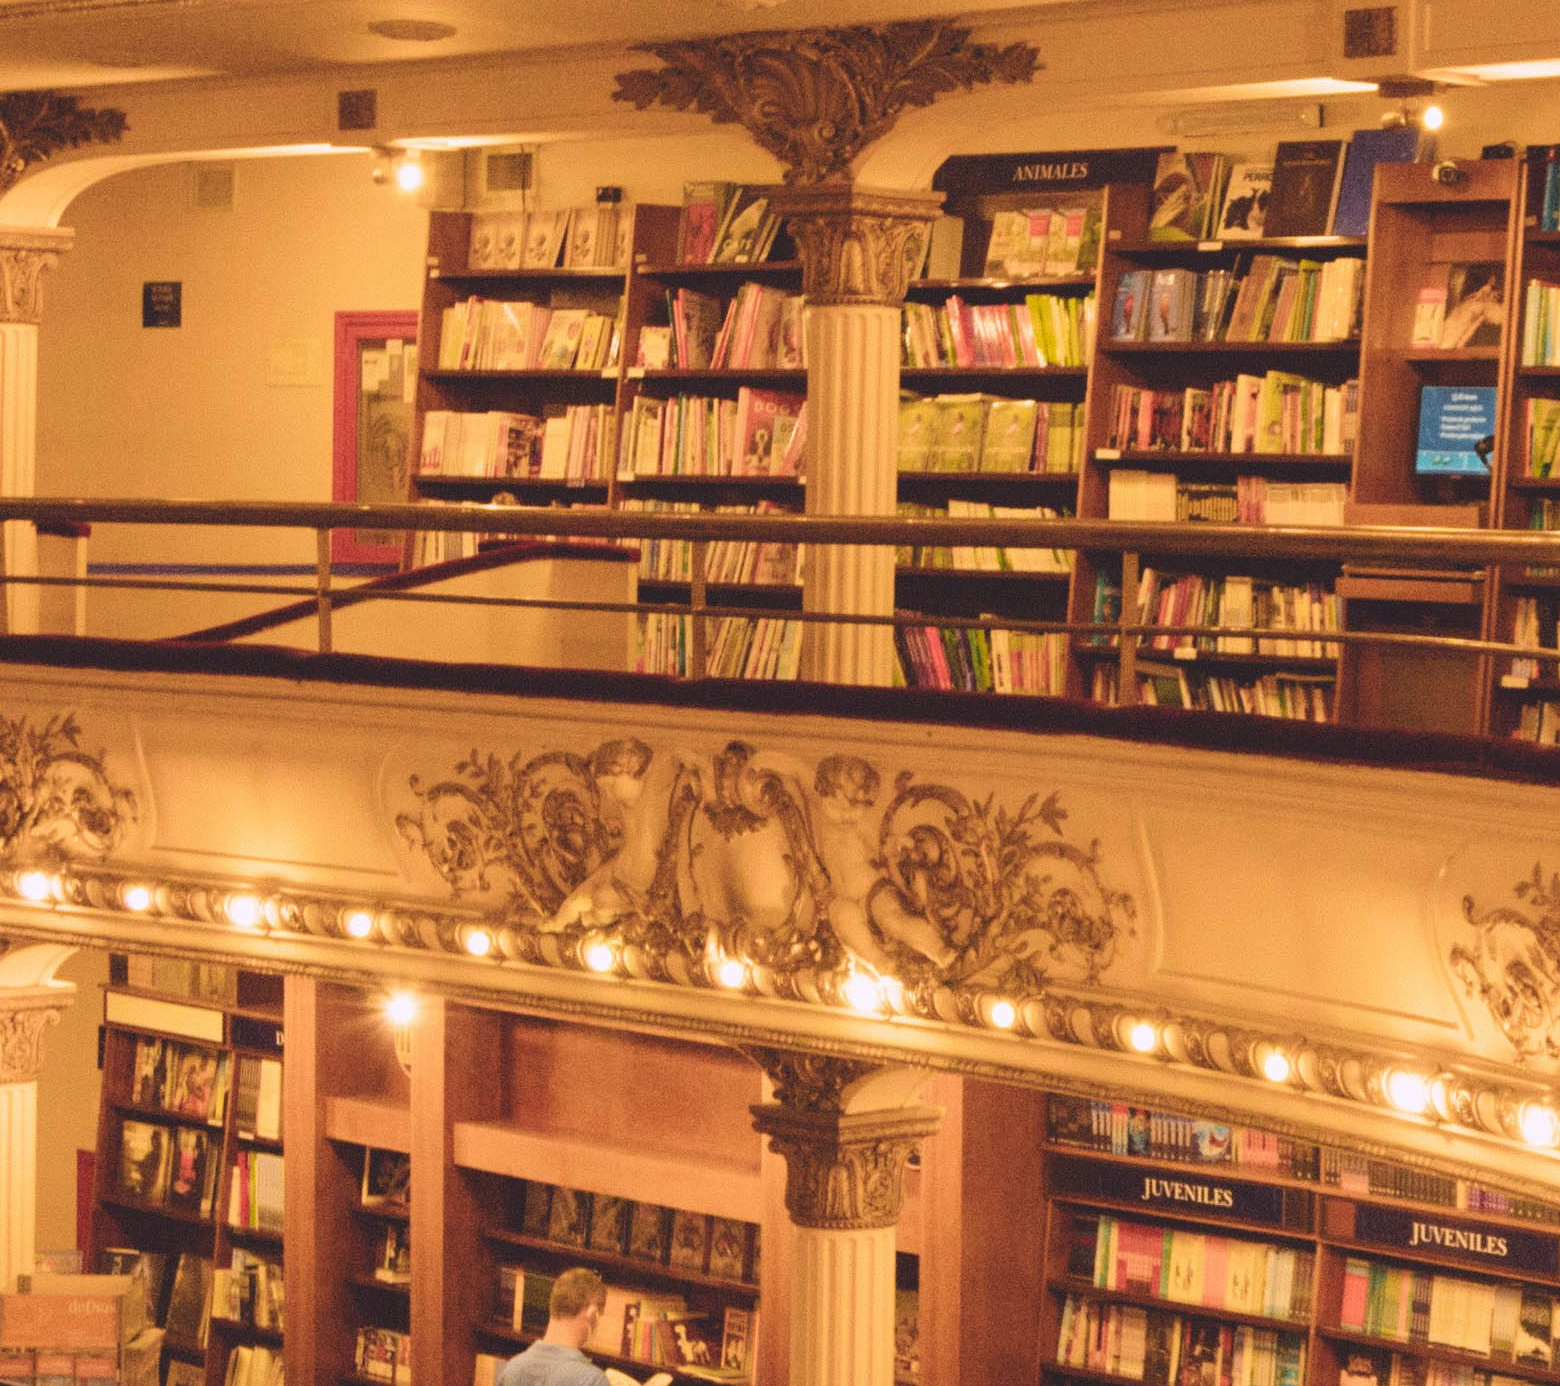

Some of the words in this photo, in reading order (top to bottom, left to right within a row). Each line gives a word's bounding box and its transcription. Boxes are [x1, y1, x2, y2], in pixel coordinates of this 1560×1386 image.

[1013, 161, 1089, 182] ANIMALES
[1142, 1176, 1235, 1208] JUVENILES
[1409, 1220, 1510, 1257] JUVENILES
